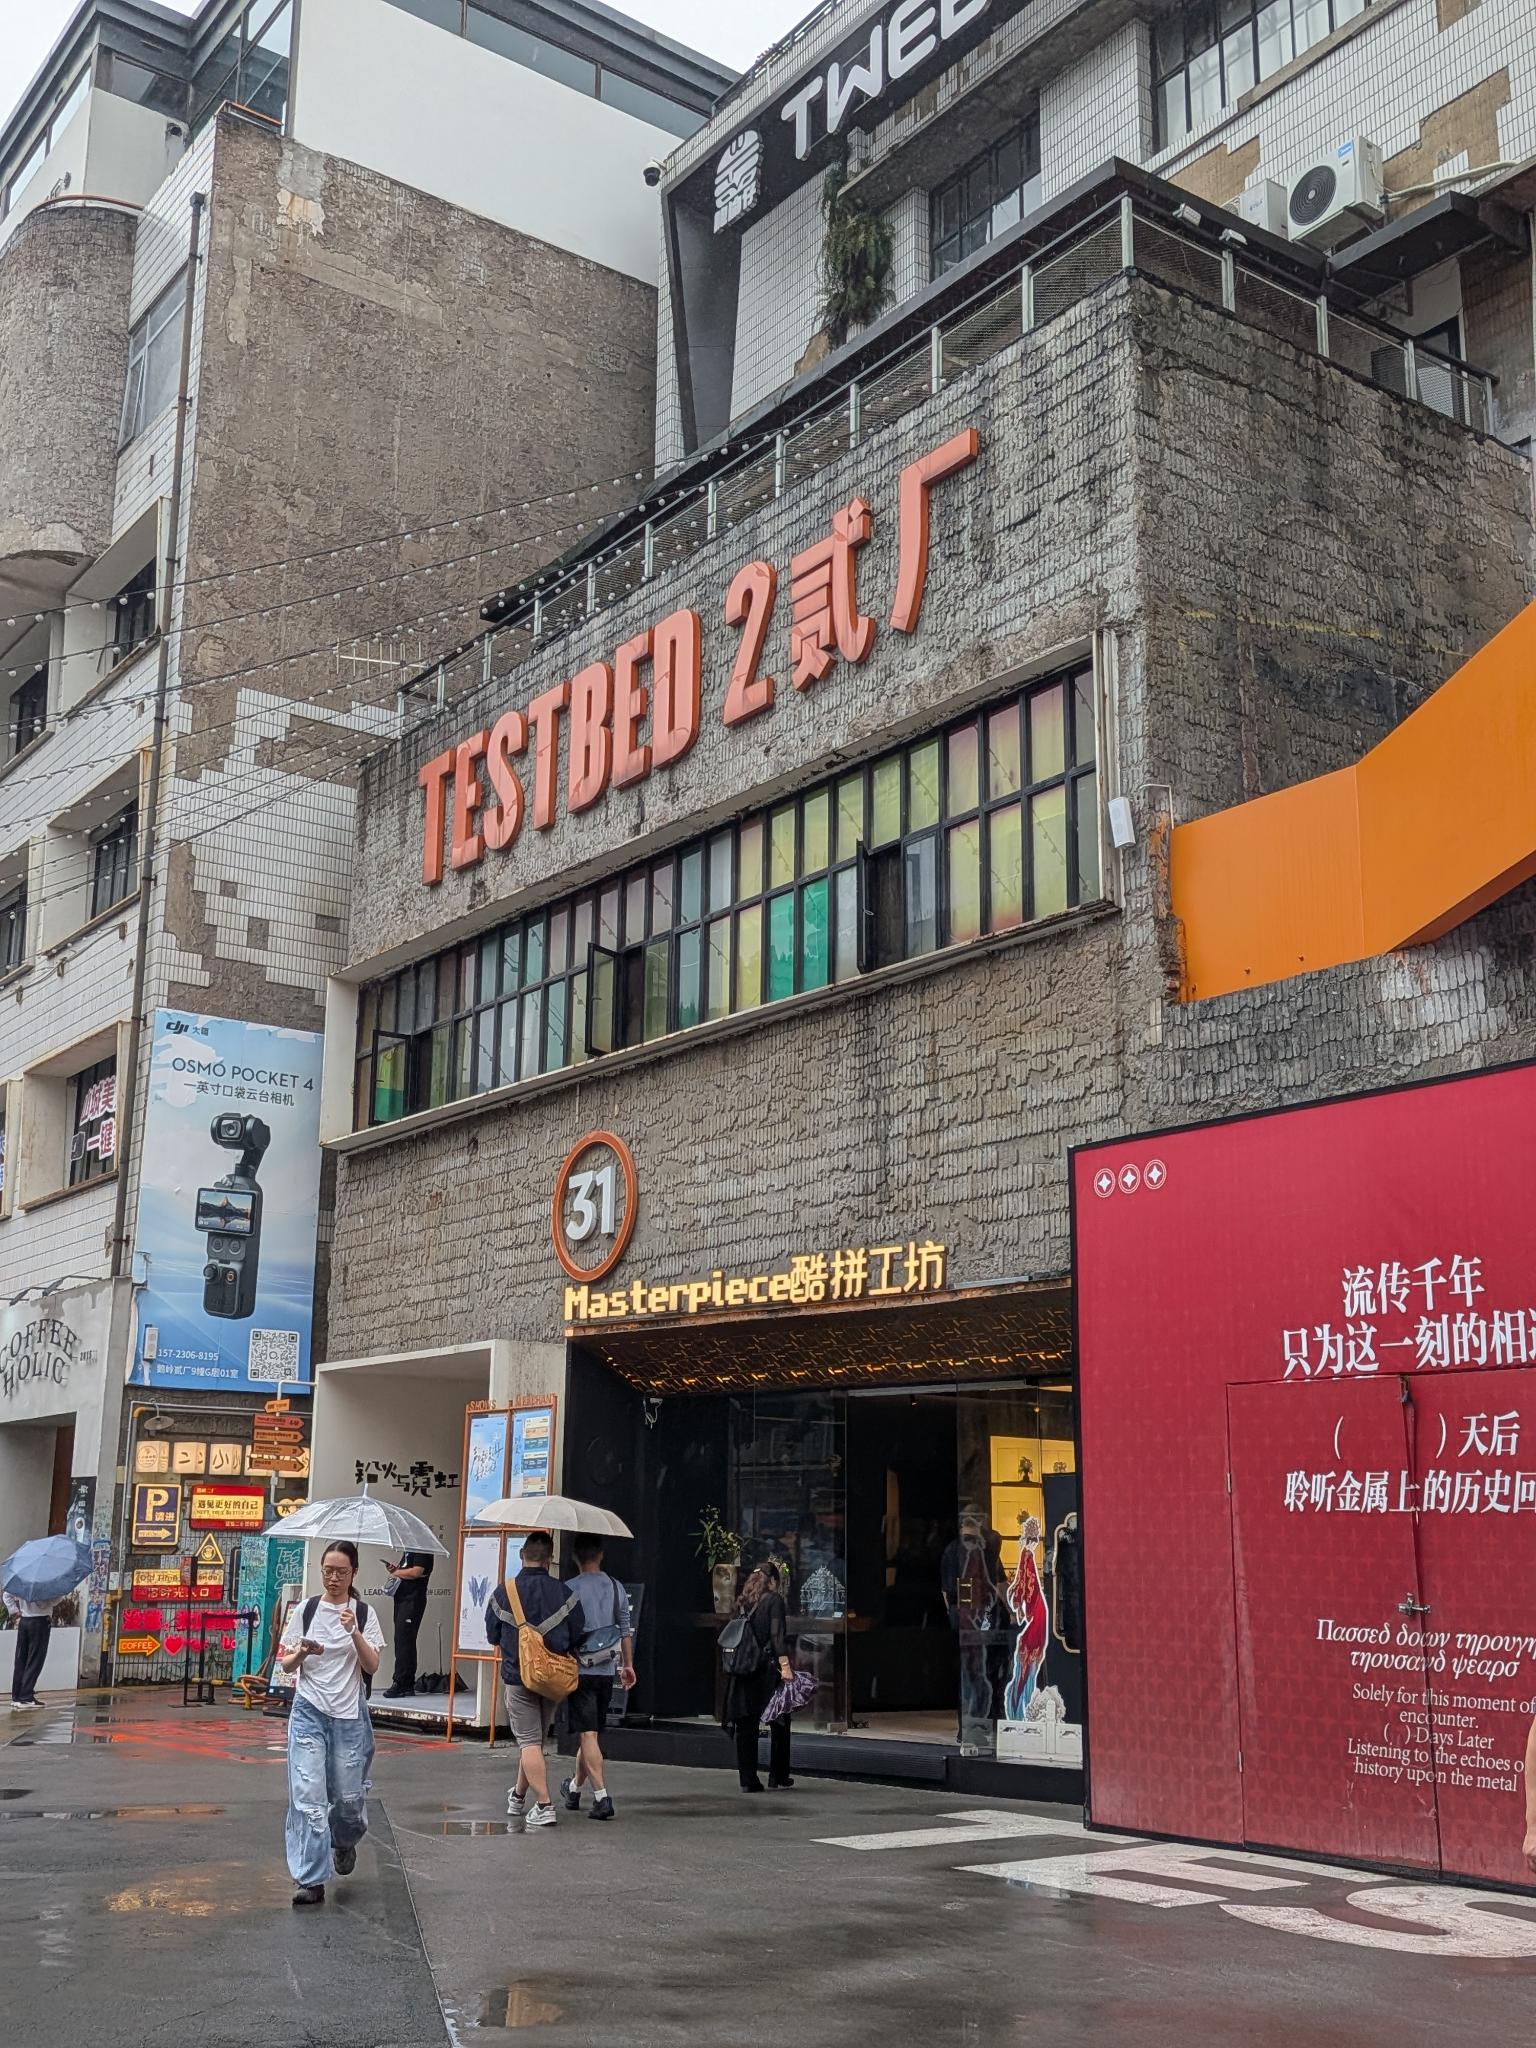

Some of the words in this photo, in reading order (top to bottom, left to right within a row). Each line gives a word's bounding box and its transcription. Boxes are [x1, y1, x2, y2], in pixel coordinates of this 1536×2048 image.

[418, 607, 702, 887] TESTBED
[172, 1057, 226, 1078] OSMO
[231, 1065, 300, 1089] POCKET
[303, 1078, 314, 1091] 4
[183, 1080, 295, 1107] 一英寸口袋云台相机
[565, 1165, 617, 1241] 31
[1342, 1254, 1486, 1318] 流传千年
[3, 1352, 66, 1397] HOLIC
[355, 1459, 461, 1497] 铅火与霓虹
[146, 1488, 169, 1521] P
[364, 1588, 383, 1596] LEAD
[121, 1641, 154, 1651] COFFEE
[1353, 1683, 1394, 1707] Solely
[1397, 1686, 1419, 1705] for
[1422, 1688, 1449, 1706] this
[1453, 1695, 1516, 1713] moment
[1399, 1710, 1479, 1729] encounter.
[1347, 1737, 1411, 1766] Listening
[1414, 1748, 1430, 1763] to
[1435, 1747, 1458, 1766] the
[1460, 1750, 1511, 1772] echoes
[1416, 1726, 1454, 1750] Days
[1457, 1730, 1495, 1750] Later
[1354, 1756, 1404, 1784] history
[1407, 1768, 1447, 1787] upon
[1451, 1769, 1473, 1786] the
[1476, 1774, 1518, 1792] metal
